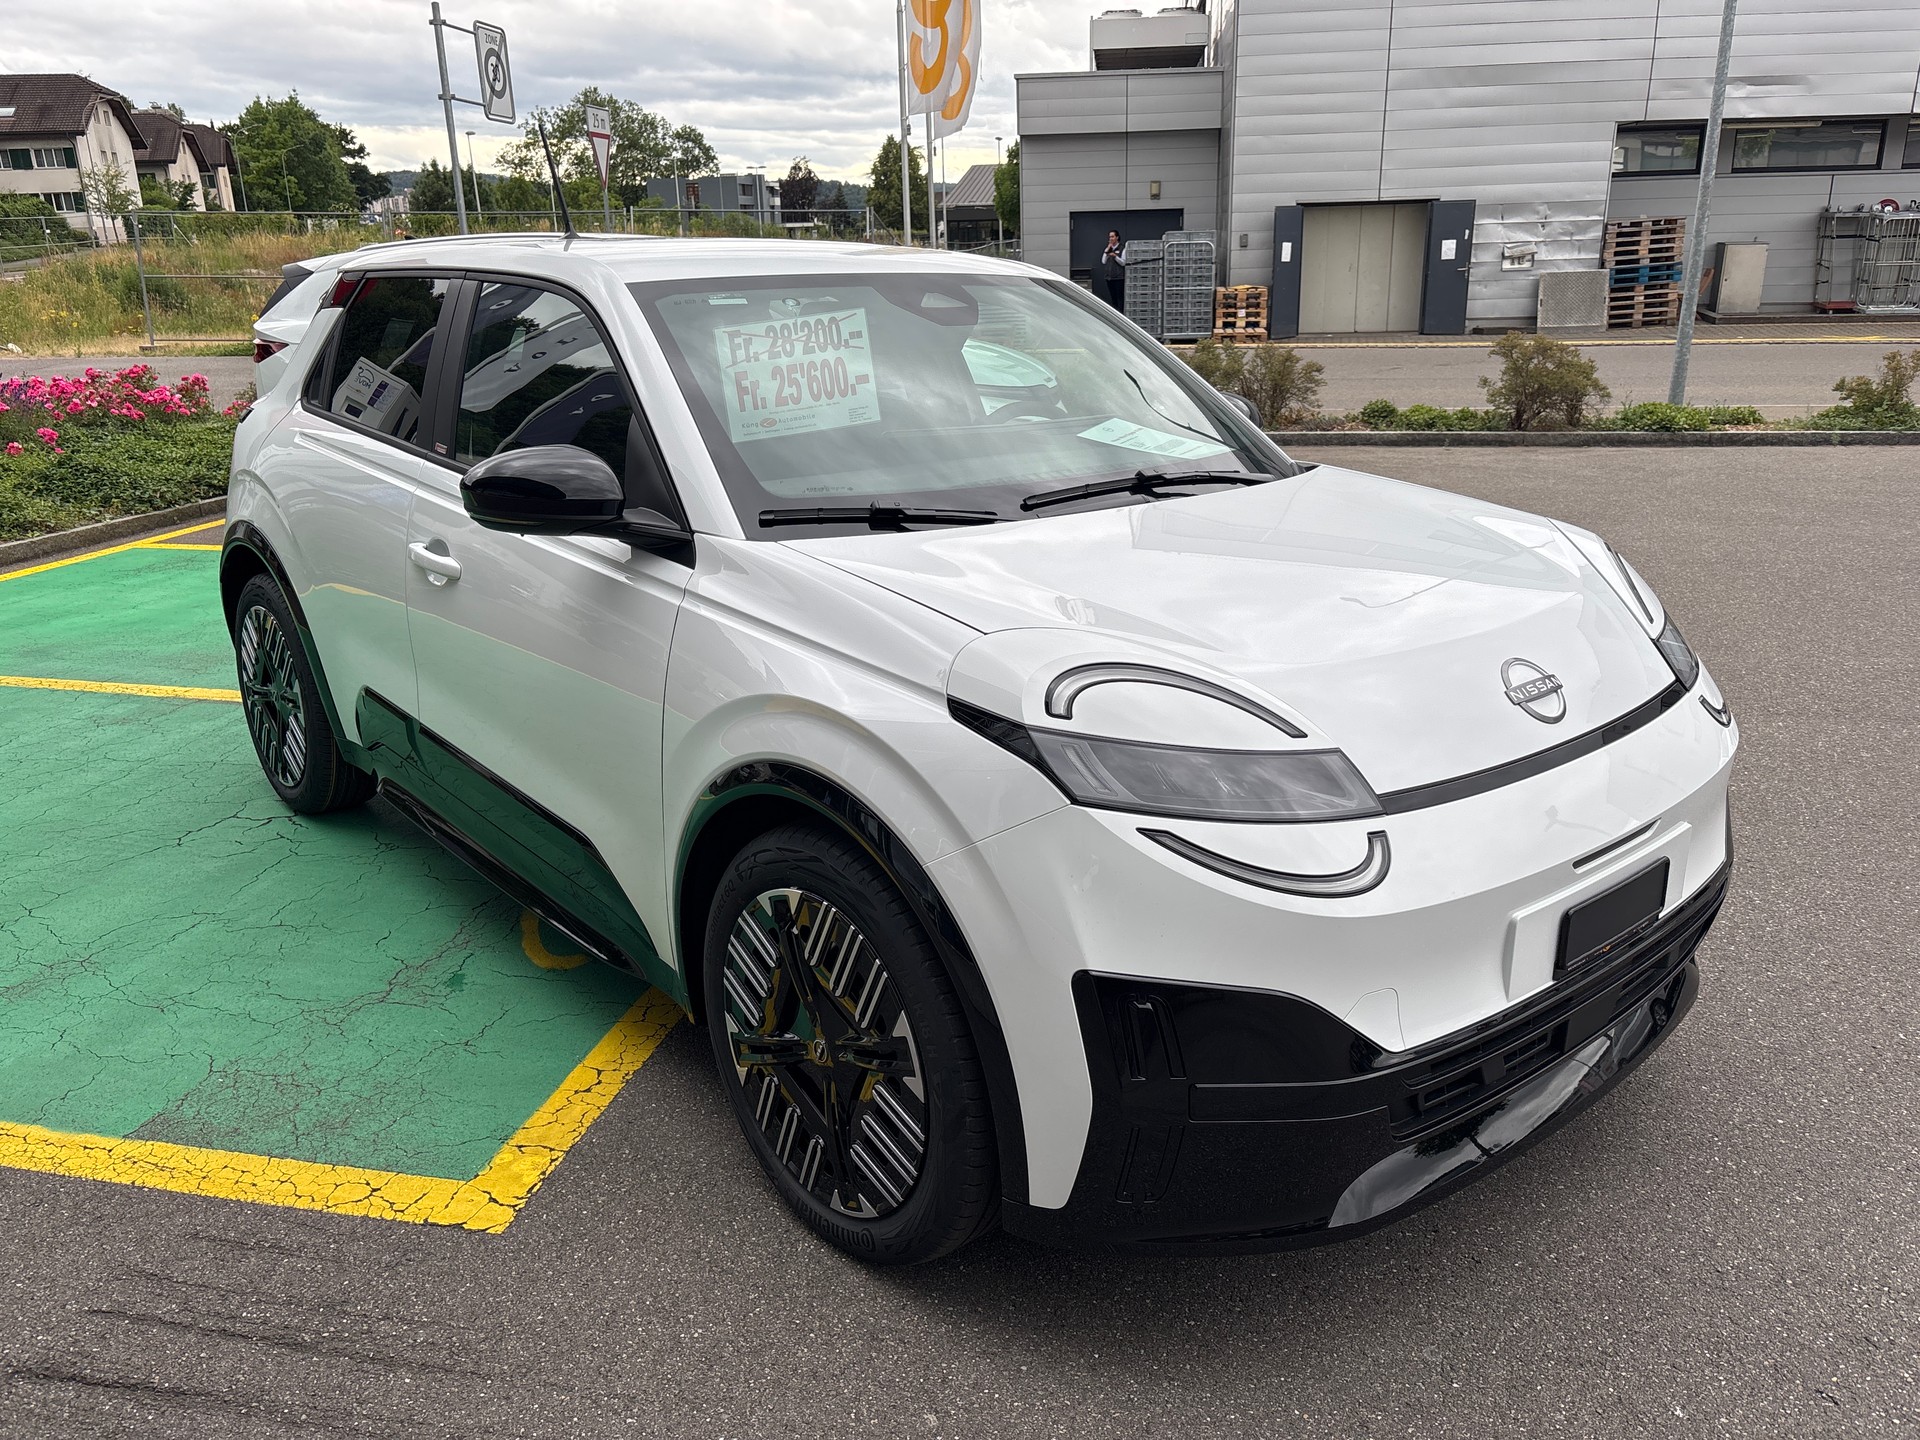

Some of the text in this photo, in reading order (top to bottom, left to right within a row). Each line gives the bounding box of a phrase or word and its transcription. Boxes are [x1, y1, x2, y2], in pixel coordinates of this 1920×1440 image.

[484, 33, 499, 46] ZONE
[490, 62, 501, 83] 30
[592, 112, 607, 130] 25 m
[728, 330, 760, 365] Fr.
[735, 371, 767, 412] Fr.
[778, 413, 816, 424] Automobile
[1509, 676, 1562, 702] NISSAN
